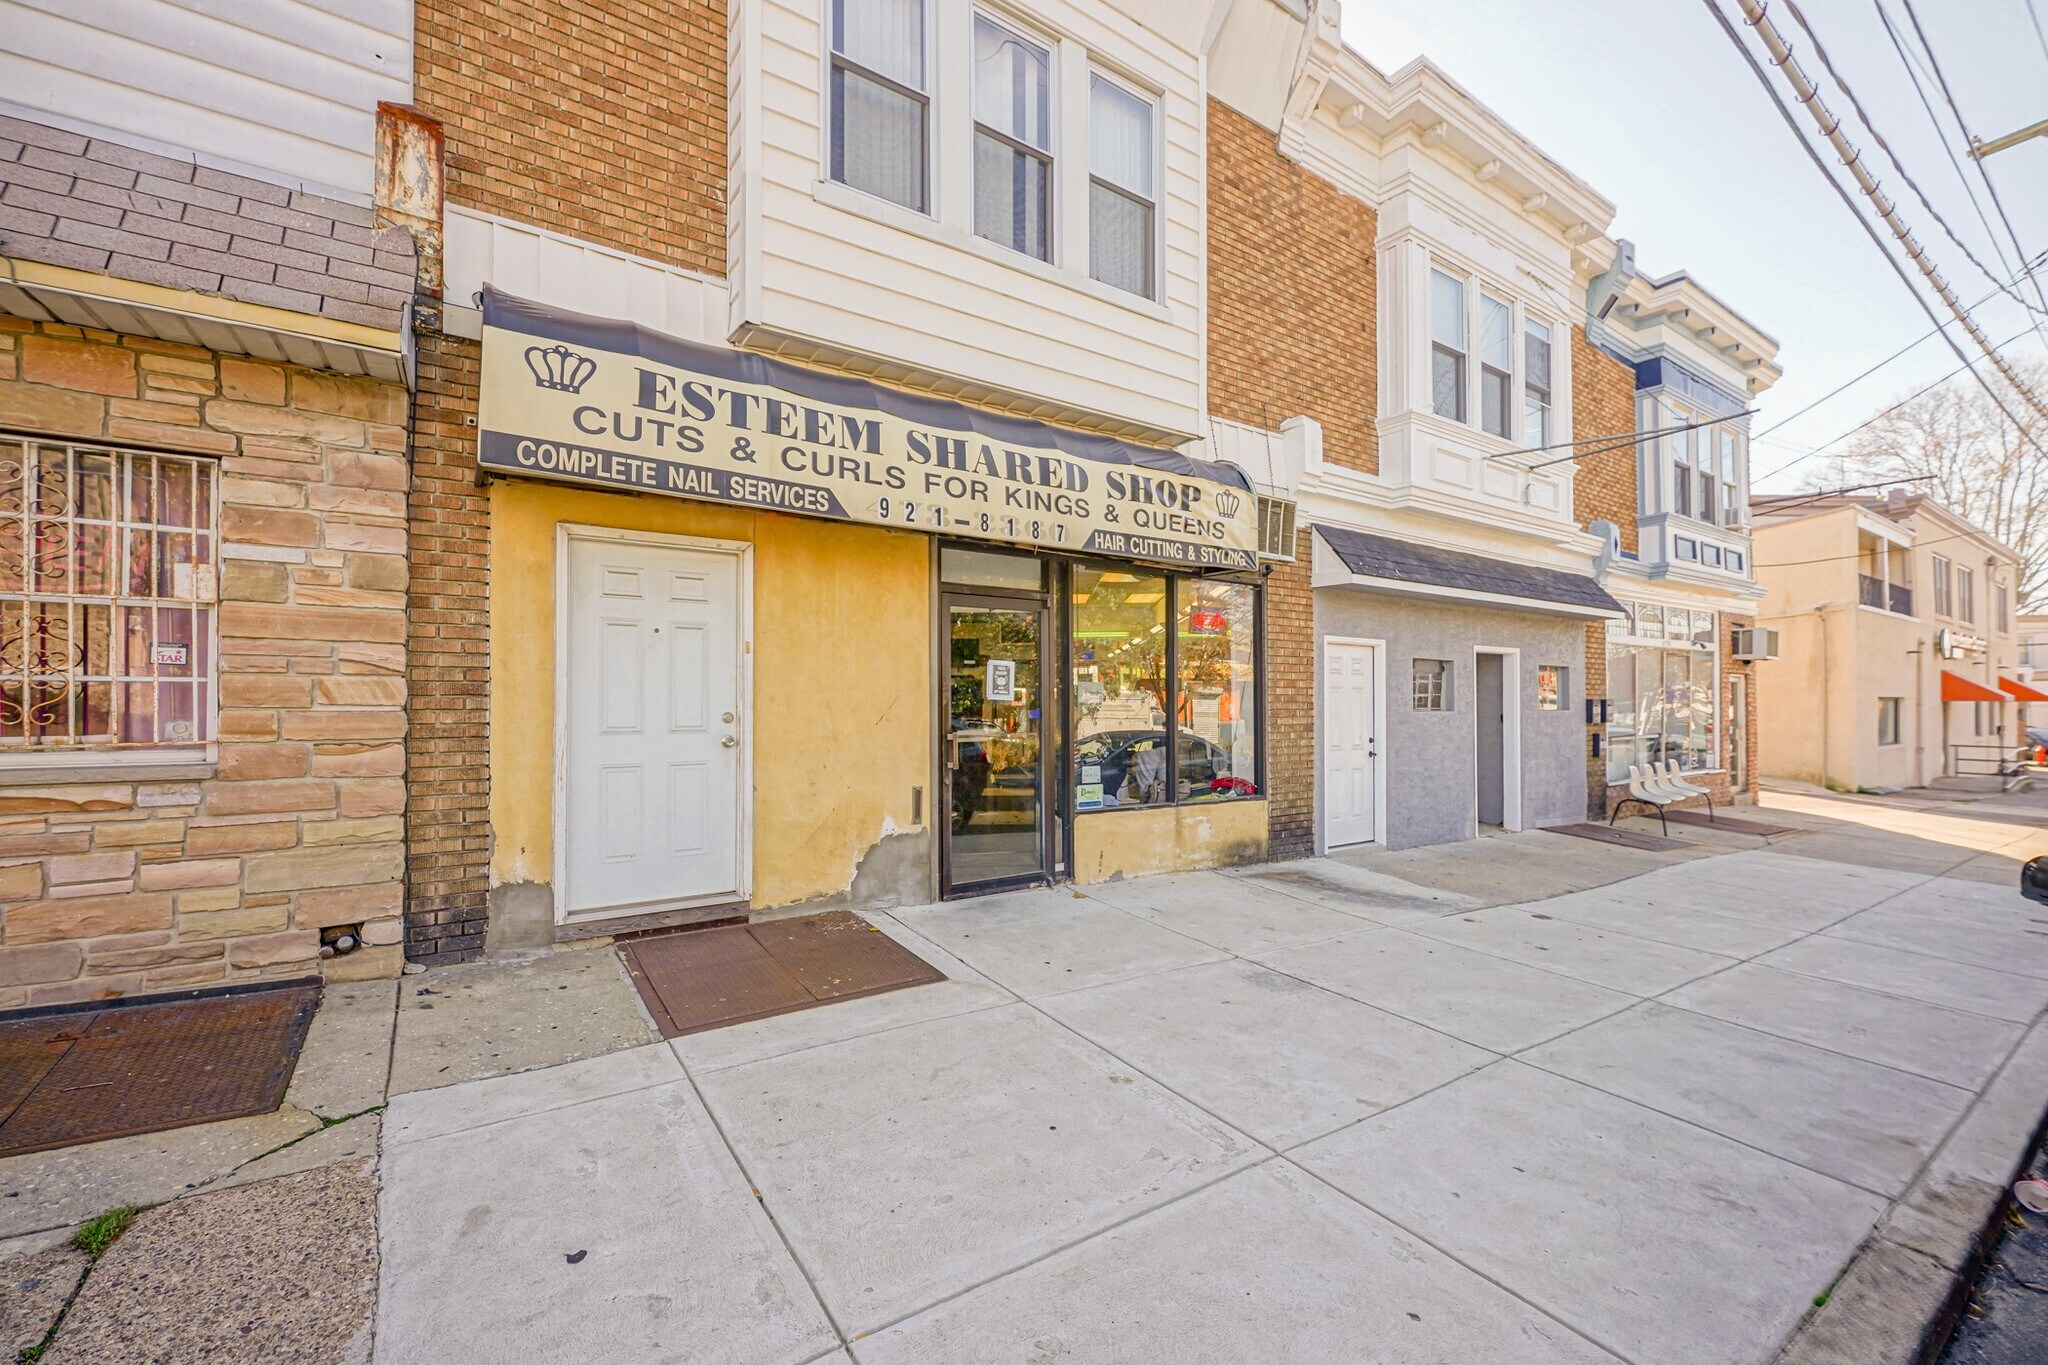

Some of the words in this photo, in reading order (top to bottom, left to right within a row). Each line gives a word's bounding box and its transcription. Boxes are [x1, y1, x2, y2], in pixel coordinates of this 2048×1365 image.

[573, 406, 705, 453] CUTS
[730, 436, 757, 463] &
[781, 446, 906, 489] CURLS
[925, 472, 989, 503] FOR
[1005, 486, 1090, 518] KINGS
[1104, 504, 1120, 524] &
[1133, 508, 1225, 540] QUEENS
[633, 367, 884, 456] ESTEEM
[906, 429, 1089, 493] SHARED
[1106, 470, 1202, 512] SHOP
[516, 440, 657, 486] COMPLETE
[668, 465, 720, 496] NAIL
[729, 476, 830, 513] SERVICES
[1095, 532, 1125, 552] HAIR
[1130, 537, 1183, 559] CUTTING
[1188, 545, 1196, 561] &
[1200, 546, 1246, 567] STYLING
[155, 654, 182, 663] TAR
